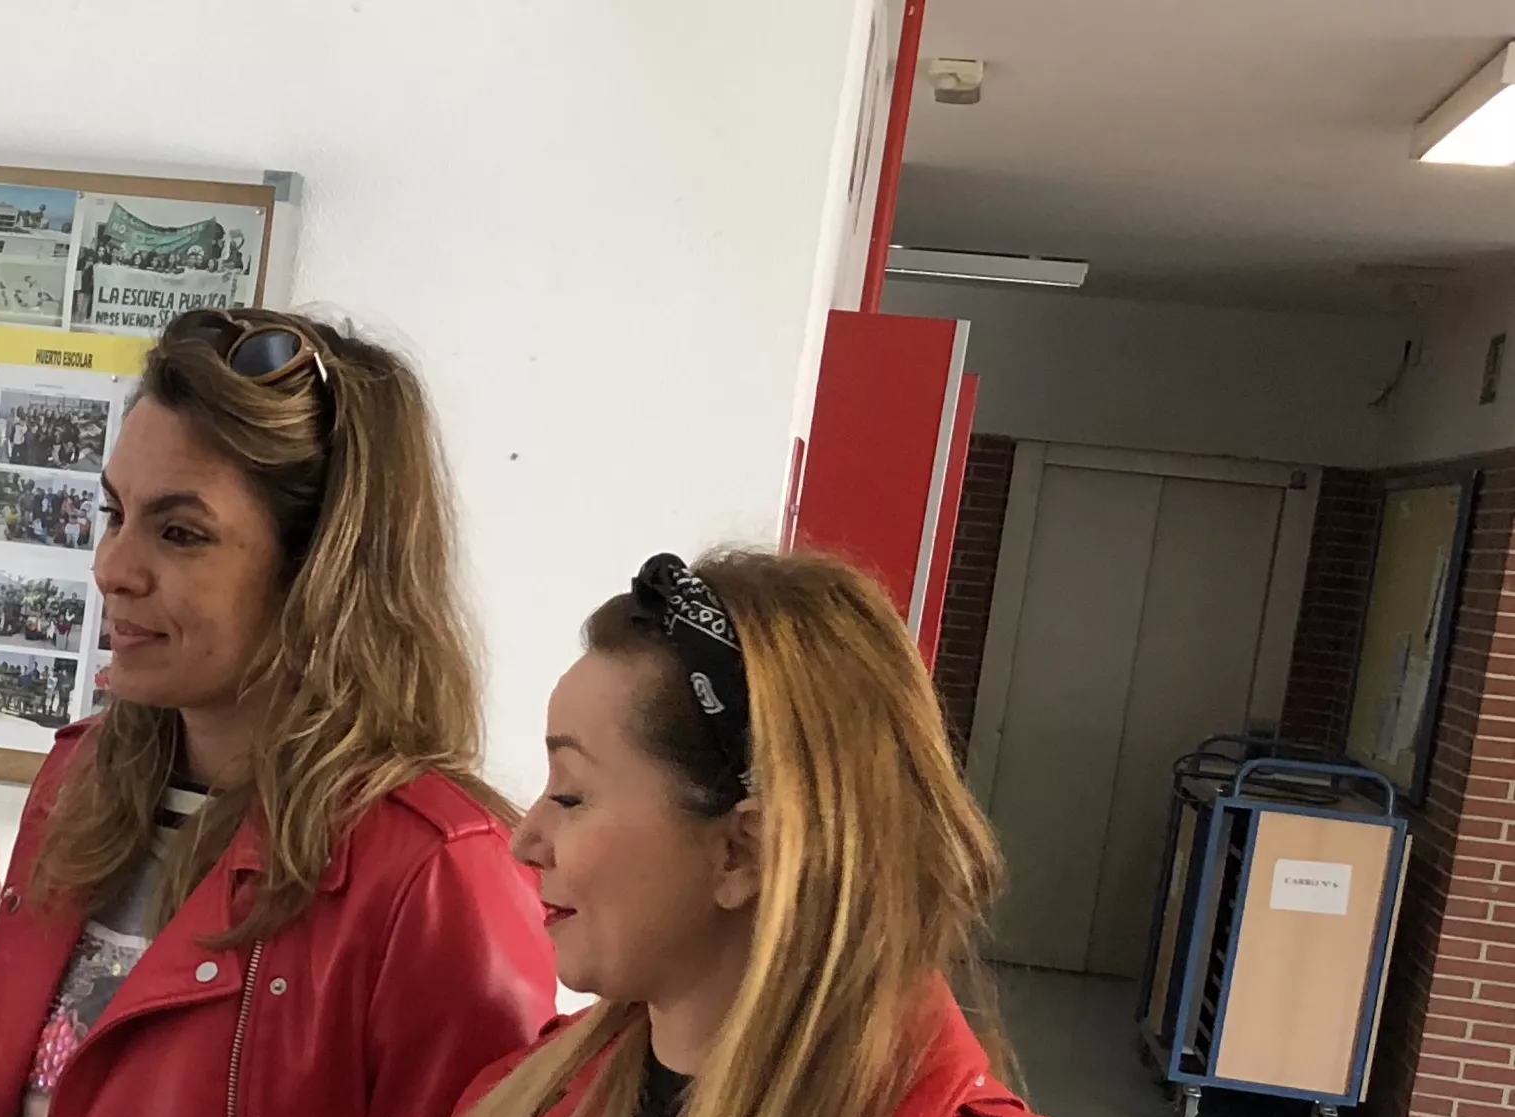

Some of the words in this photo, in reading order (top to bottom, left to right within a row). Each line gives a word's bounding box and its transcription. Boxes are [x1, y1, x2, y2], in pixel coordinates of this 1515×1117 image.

[98, 286, 119, 304] LA
[122, 288, 174, 309] ESCUELA
[122, 312, 156, 328] VENDE
[35, 349, 61, 366] HUERTO
[63, 351, 93, 369] ESCOLAR
